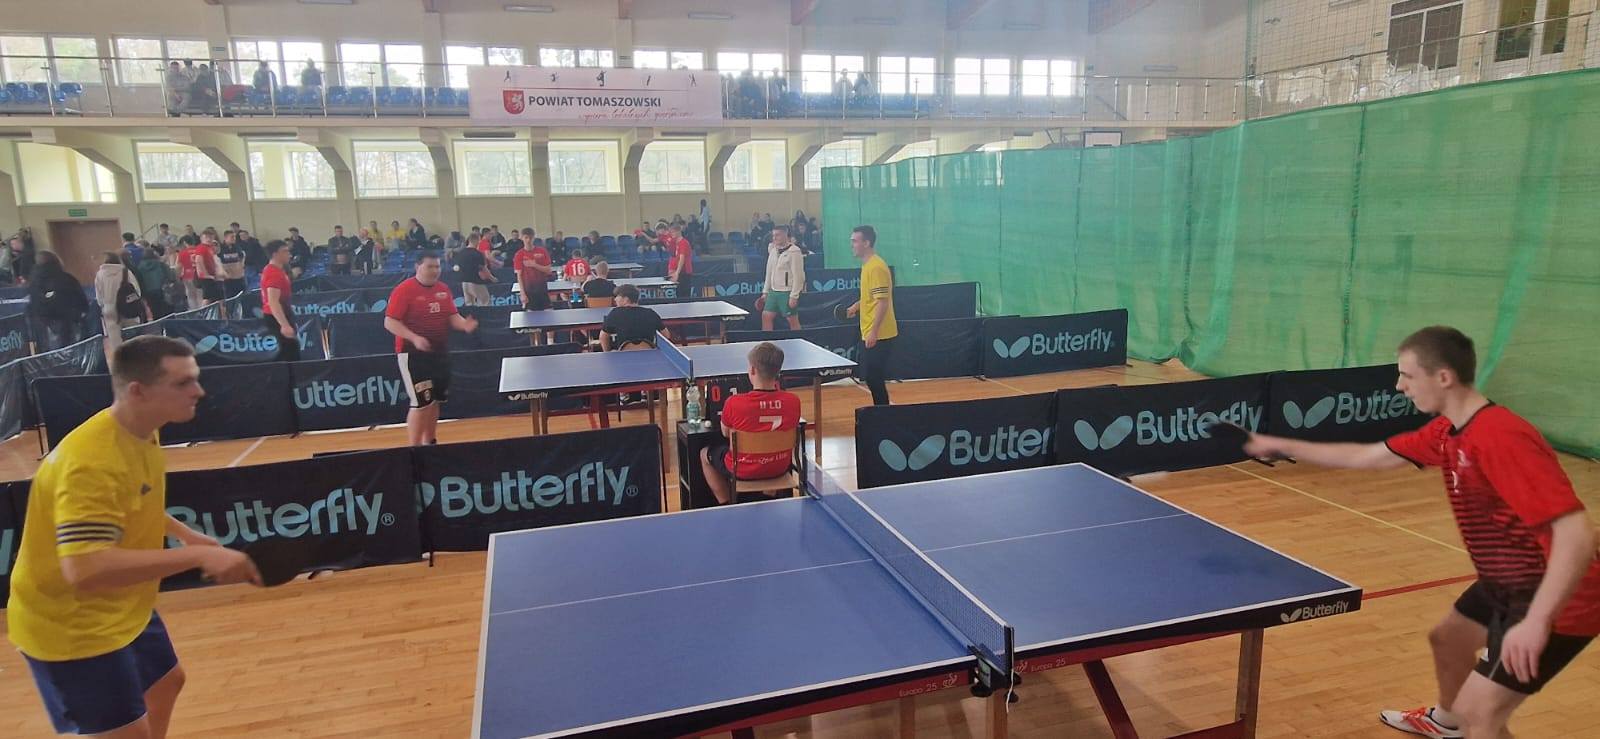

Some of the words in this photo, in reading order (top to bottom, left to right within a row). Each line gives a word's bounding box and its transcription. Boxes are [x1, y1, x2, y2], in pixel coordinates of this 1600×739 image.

[528, 96, 575, 107] POWIAT
[578, 96, 662, 108] TOMASZOWSKI
[571, 262, 585, 276] 16
[1031, 327, 1113, 356] Butterfly
[293, 376, 400, 409] utterfly
[1335, 389, 1418, 425] Butter
[949, 424, 1050, 466] Butter
[440, 461, 631, 518] Butterfly
[1302, 600, 1349, 620] Butterfly
[1055, 658, 1067, 667] 25
[926, 682, 938, 692] 25
